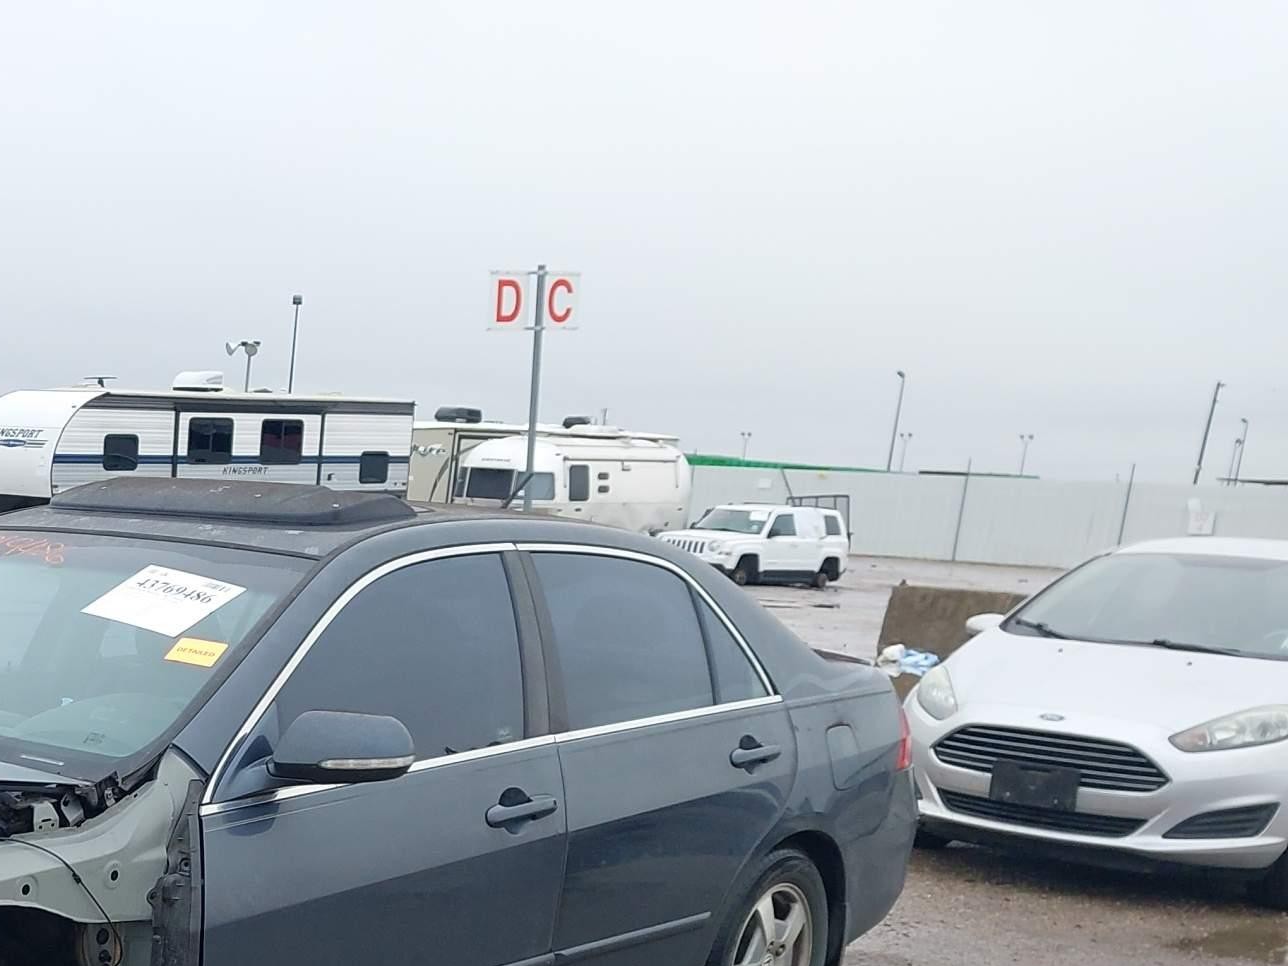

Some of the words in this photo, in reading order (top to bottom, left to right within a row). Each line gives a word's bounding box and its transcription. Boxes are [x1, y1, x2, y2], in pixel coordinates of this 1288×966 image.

[496, 279, 522, 322] D
[548, 278, 573, 323] C
[222, 466, 269, 475] KINGSPORT
[136, 578, 217, 604] 43769486
[176, 646, 216, 657] DETAILED
